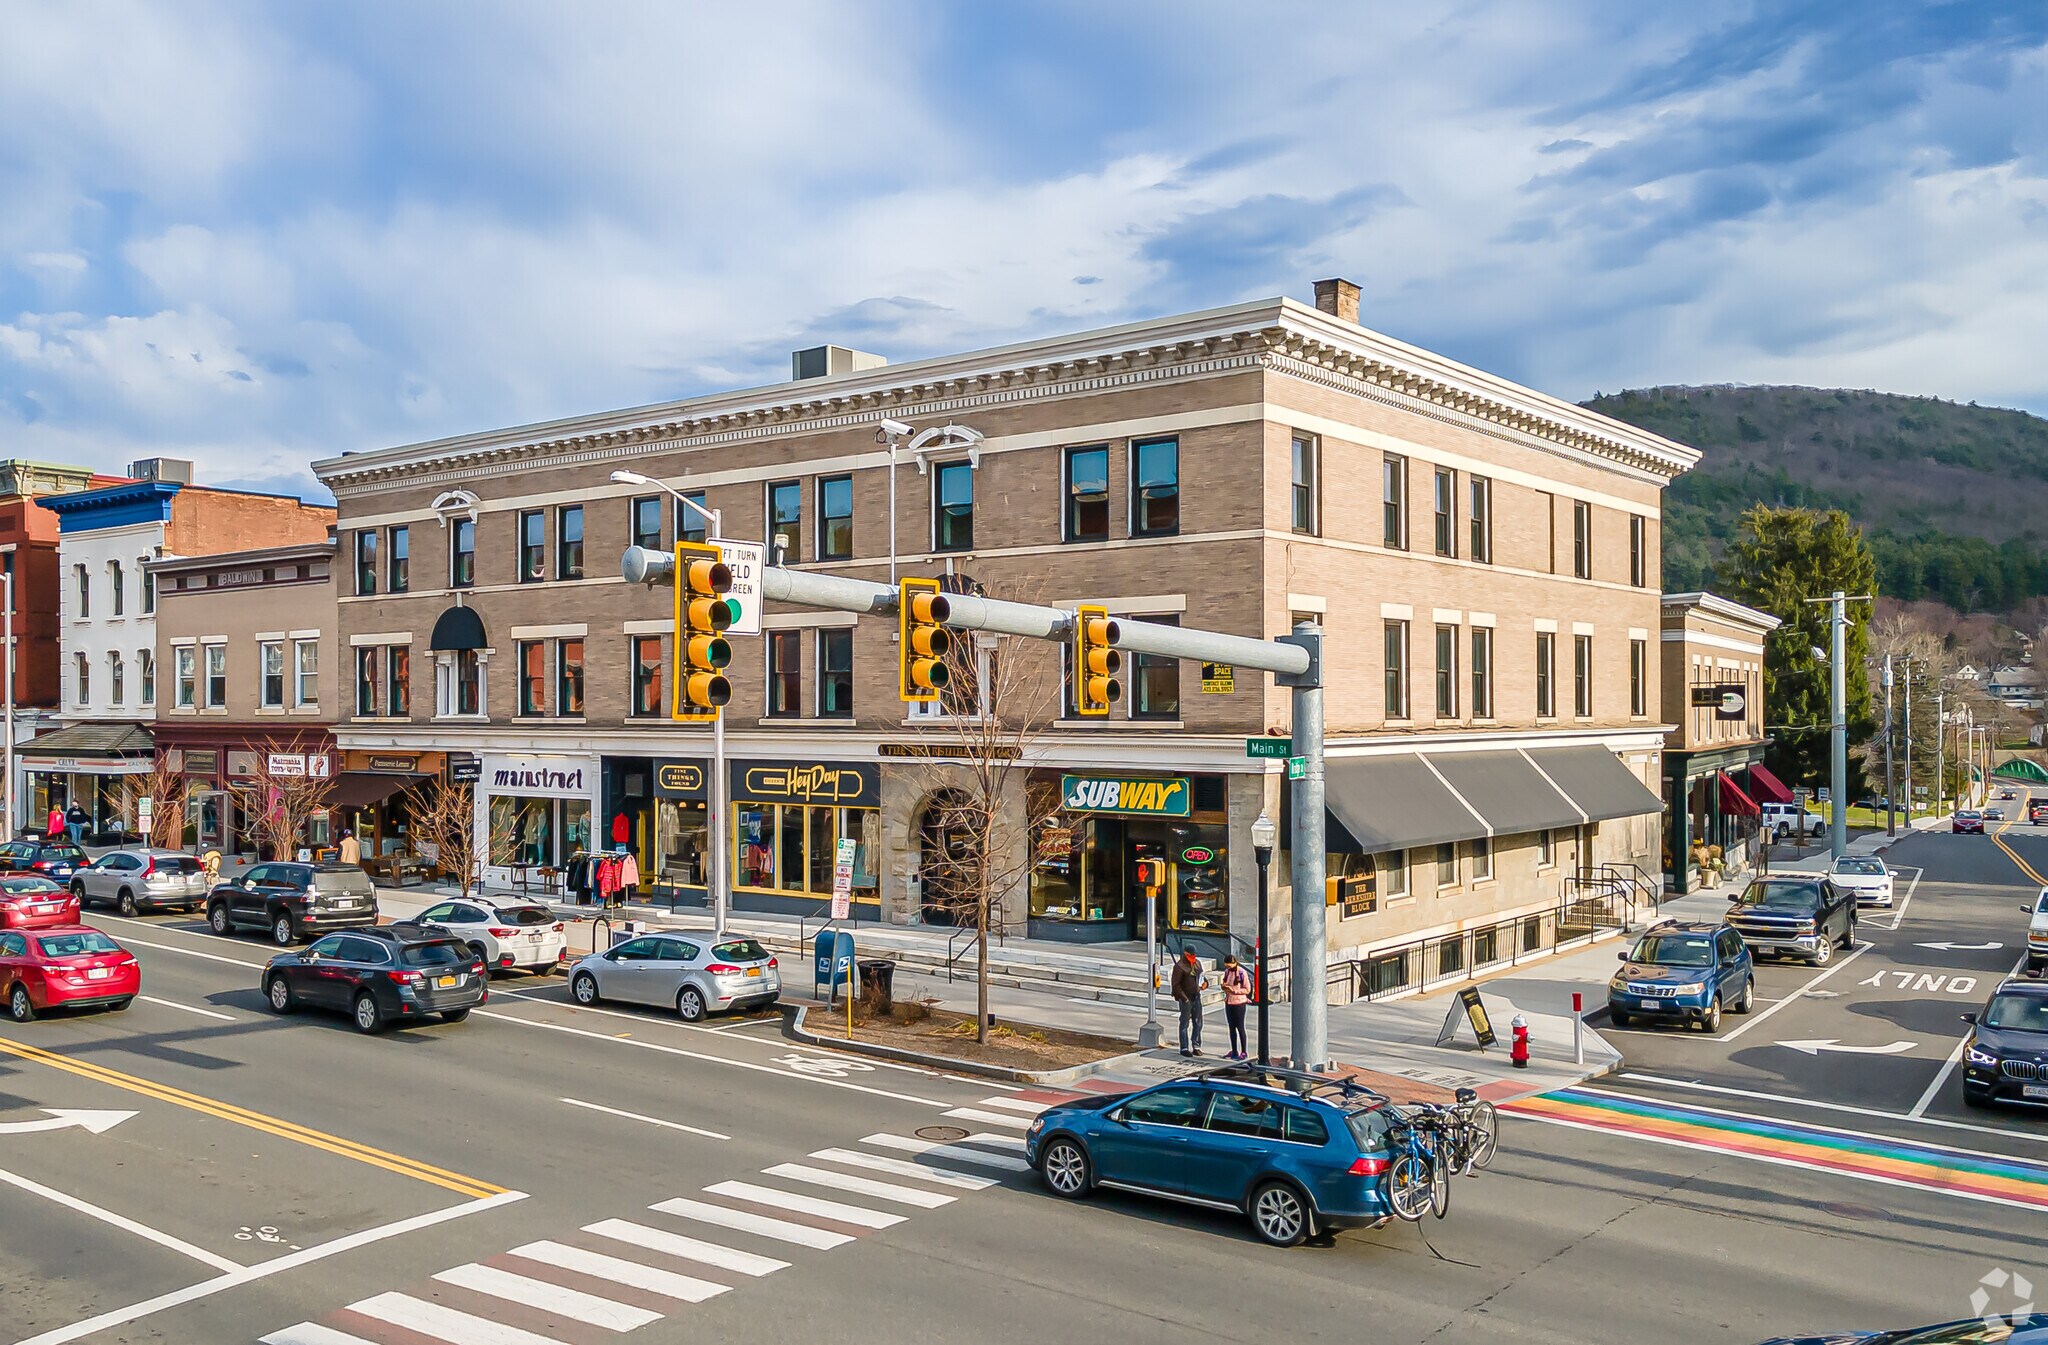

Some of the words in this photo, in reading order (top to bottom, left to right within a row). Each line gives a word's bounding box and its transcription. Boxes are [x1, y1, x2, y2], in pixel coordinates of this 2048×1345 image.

[737, 550, 757, 561] TURN
[221, 570, 257, 586] BALDWIN
[1214, 667, 1232, 675] SPACE
[887, 745, 907, 756] THE
[1251, 742, 1274, 754] Main
[1279, 745, 1287, 754] St
[494, 762, 582, 789] mainstreet
[1068, 780, 1182, 811] SUBWAY
[1186, 850, 1210, 860] OPEN
[1355, 884, 1367, 893] THE
[1351, 902, 1370, 913] BLOCK
[1857, 970, 1978, 994] ONLY
